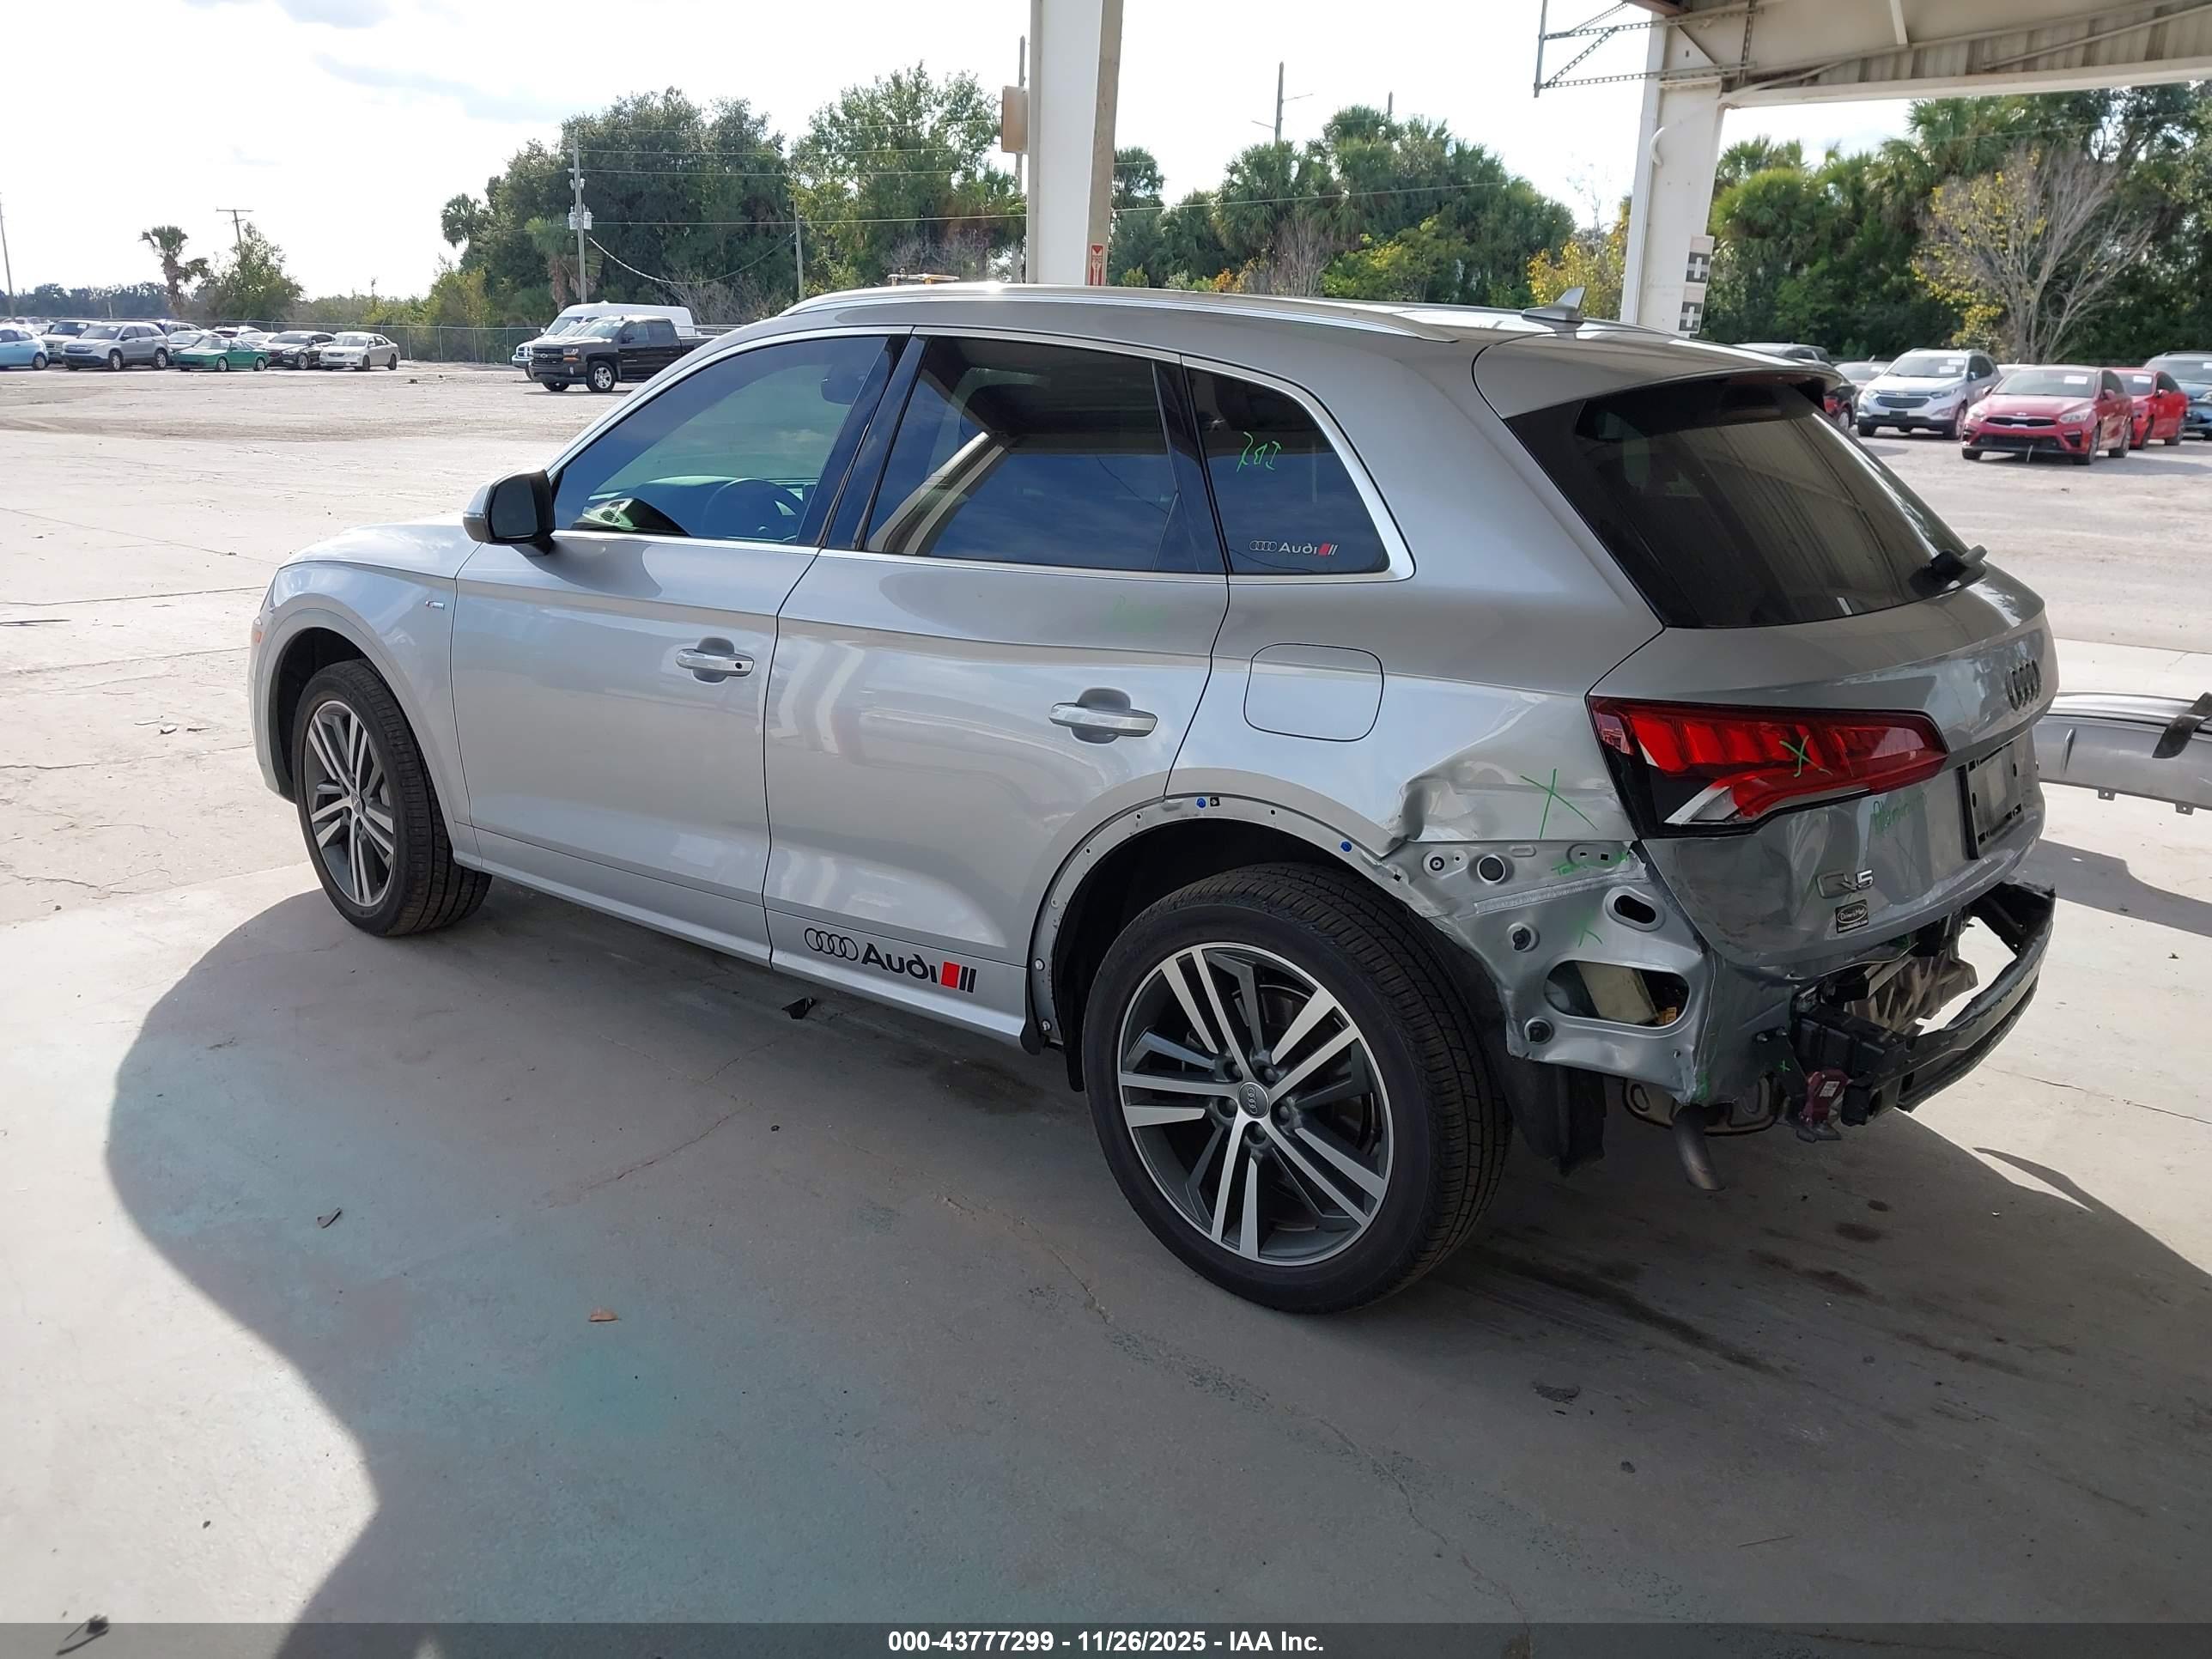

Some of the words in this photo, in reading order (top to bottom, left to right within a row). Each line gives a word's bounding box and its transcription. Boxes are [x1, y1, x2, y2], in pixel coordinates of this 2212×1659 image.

[1278, 542, 1318, 555] Audi
[1816, 868, 1874, 899] Q5
[860, 941, 939, 984] Audi
